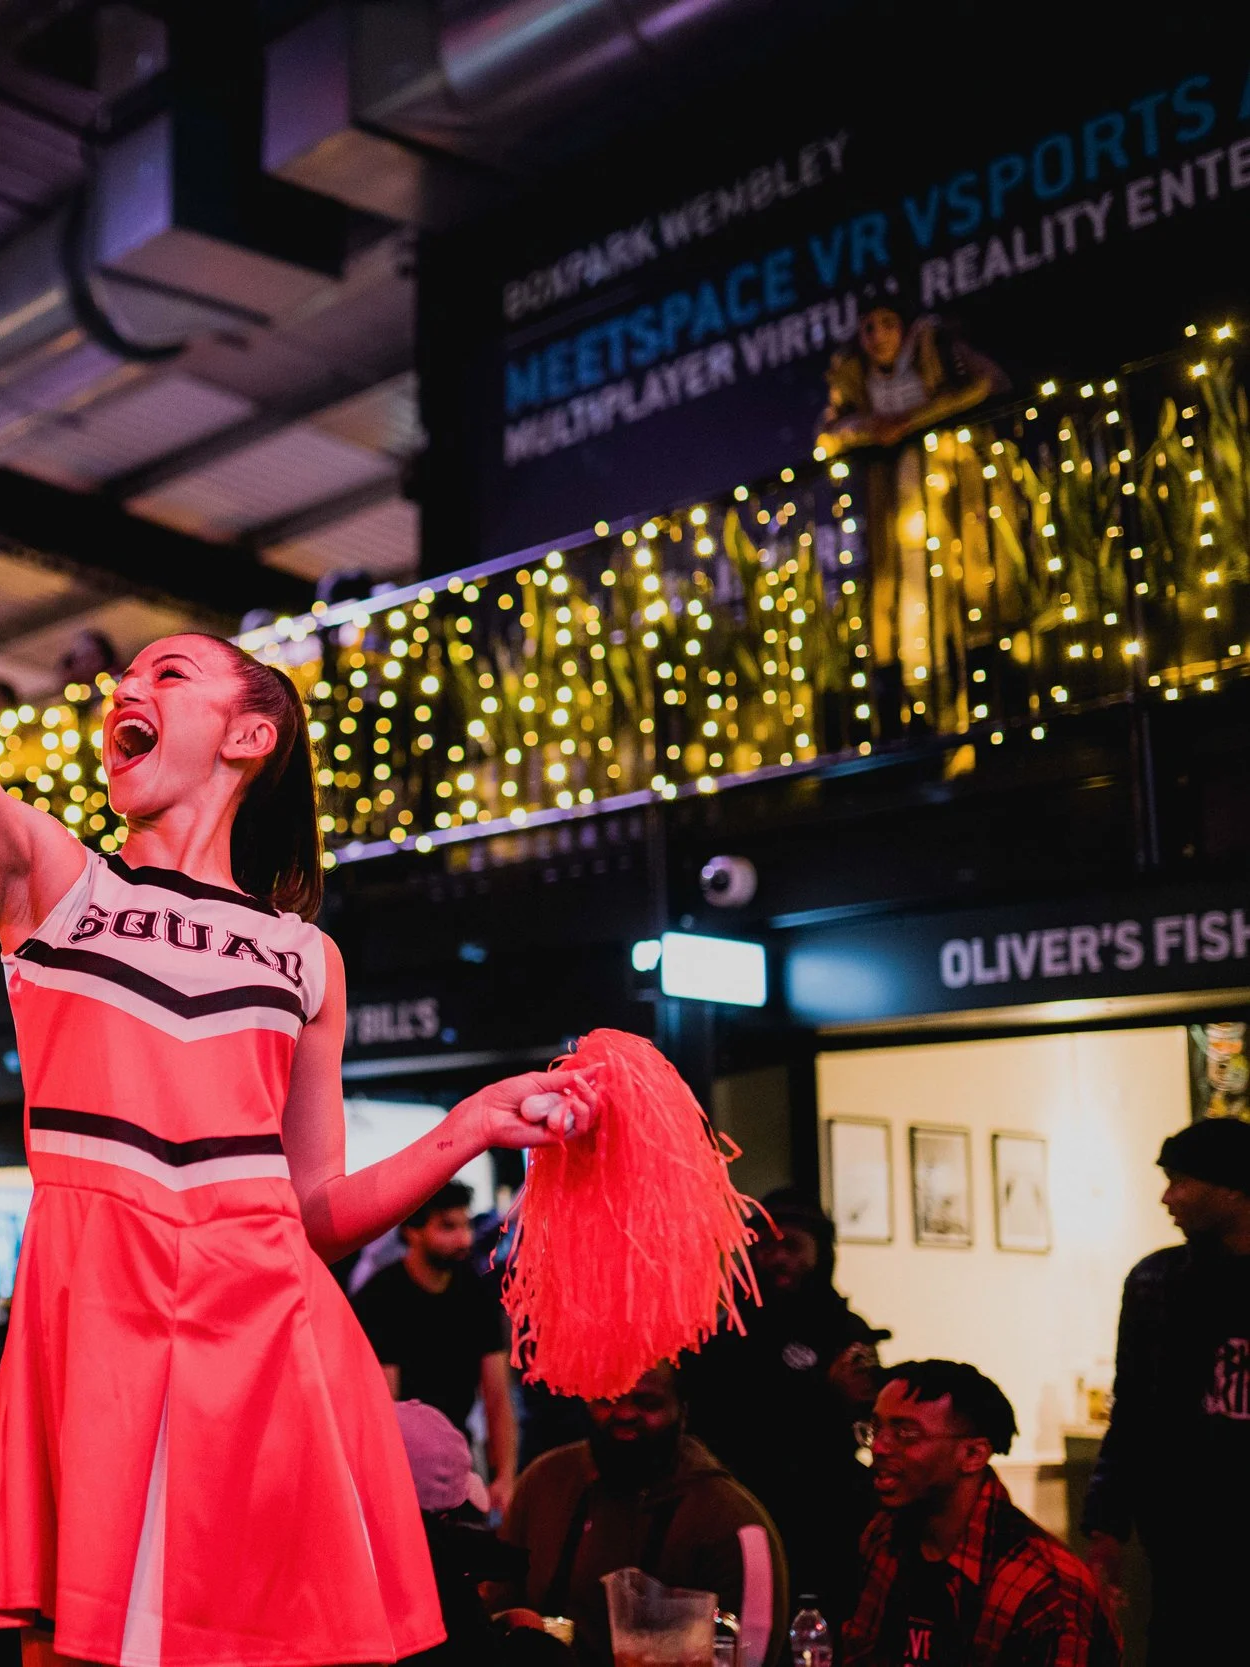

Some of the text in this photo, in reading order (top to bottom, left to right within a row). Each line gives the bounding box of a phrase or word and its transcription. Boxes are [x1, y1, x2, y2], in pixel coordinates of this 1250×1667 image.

[503, 72, 1217, 416] MEETSPACE VR VSPORTS
[658, 130, 848, 248] WEMBLEY
[503, 340, 737, 467] MULTIPLAYER
[920, 190, 1115, 309] REALITY
[68, 902, 303, 991] SQUAD
[939, 918, 1146, 990] OLIVER'S
